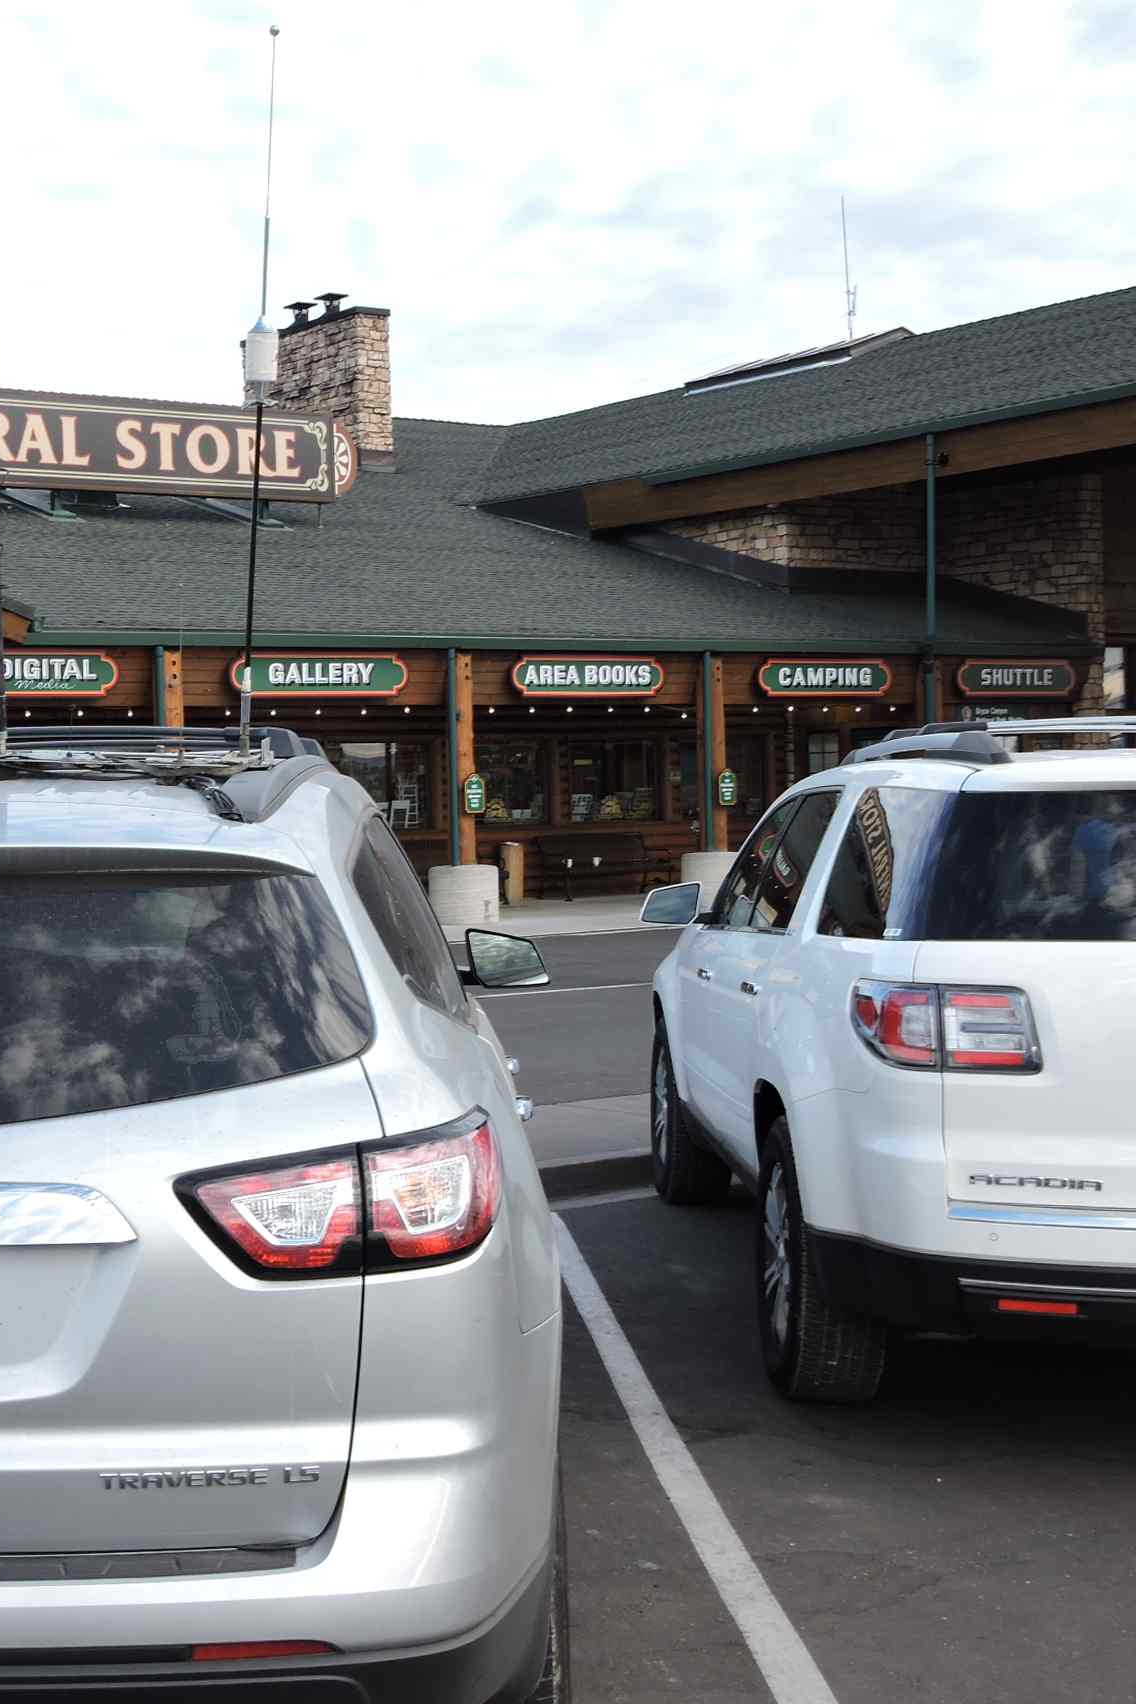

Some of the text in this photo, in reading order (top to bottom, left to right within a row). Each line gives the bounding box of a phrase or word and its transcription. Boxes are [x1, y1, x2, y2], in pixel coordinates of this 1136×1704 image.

[115, 419, 302, 478] STORE
[2, 658, 97, 680] DIGITAL
[268, 662, 375, 686] GALLERY
[524, 665, 652, 687] AREA BOOKS
[778, 667, 873, 687] CAMPING
[980, 667, 1054, 687] SHUTTLE
[13, 678, 75, 690] Media
[969, 1174, 1103, 1192] ACADIA
[99, 1465, 319, 1490] TRAVERSE LS
